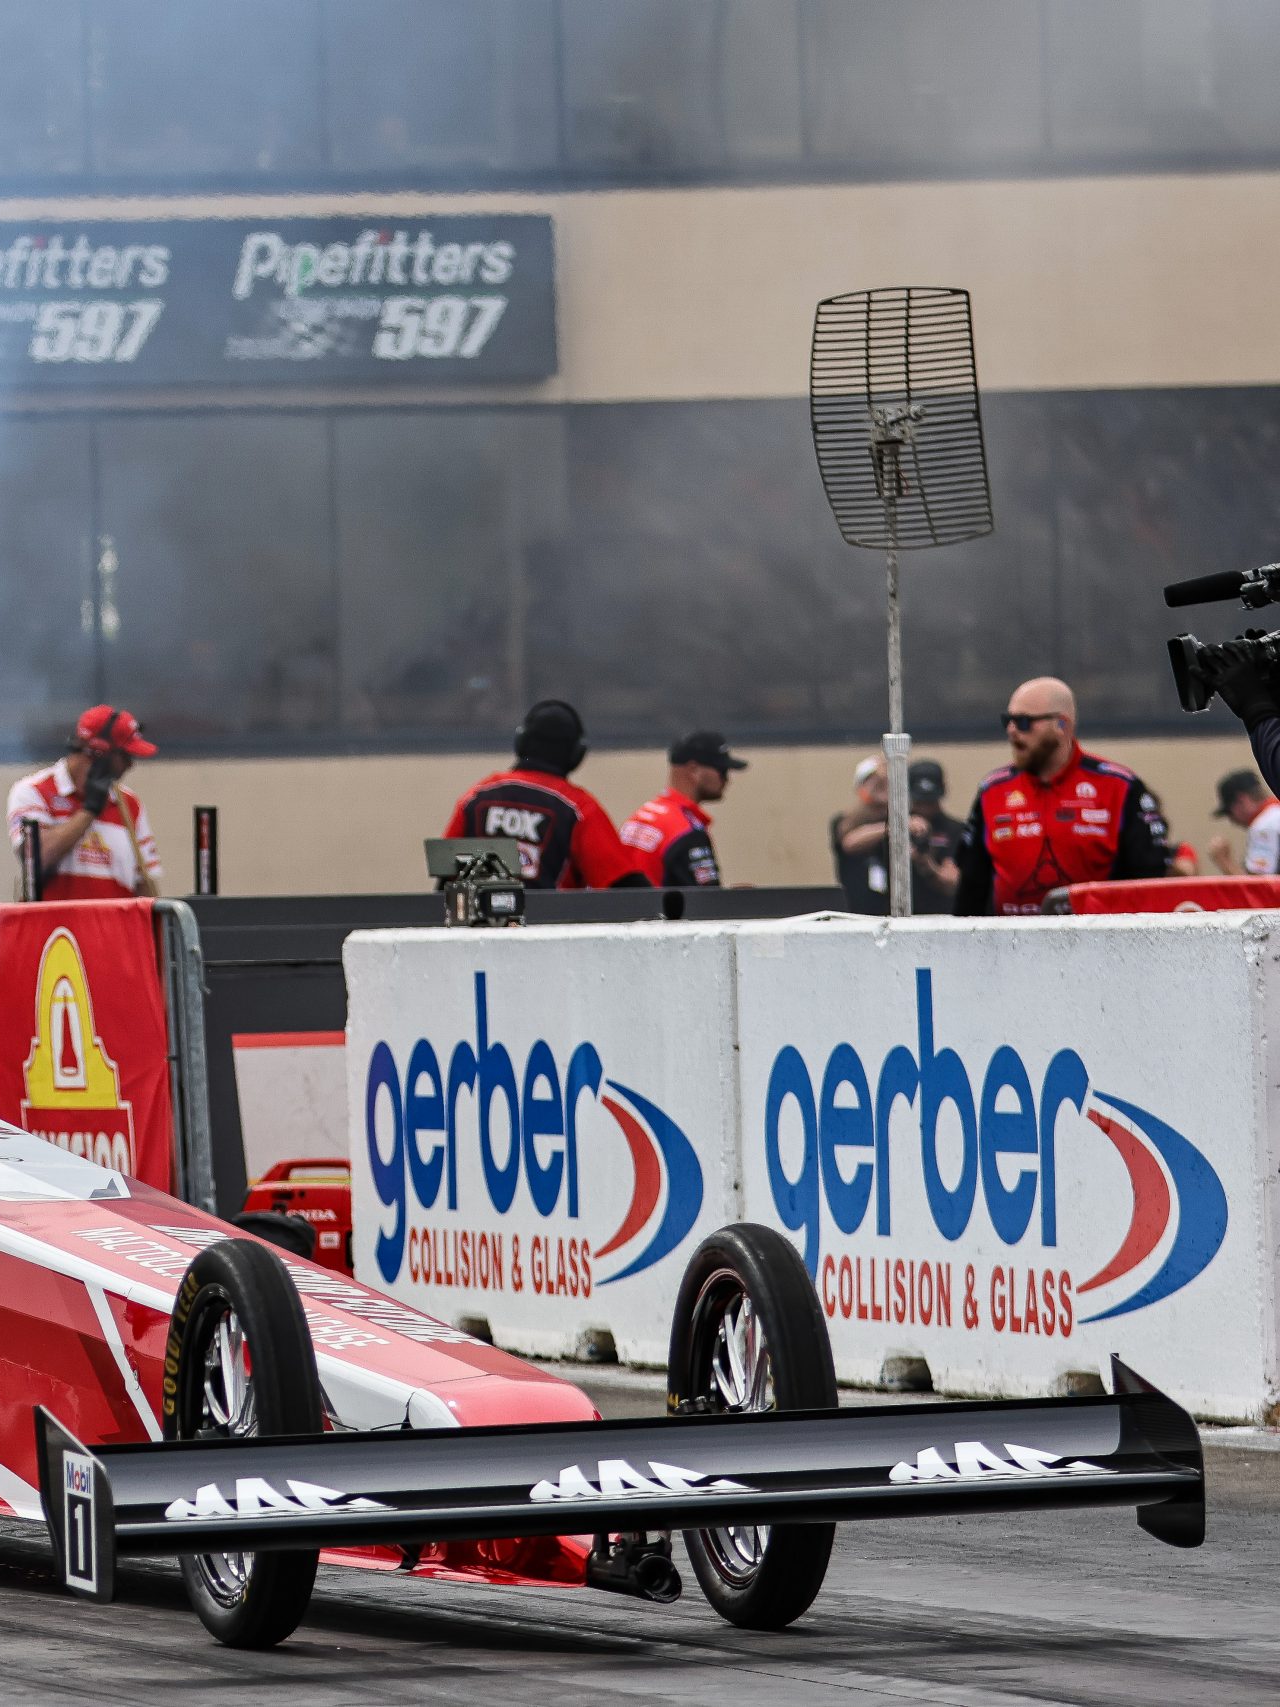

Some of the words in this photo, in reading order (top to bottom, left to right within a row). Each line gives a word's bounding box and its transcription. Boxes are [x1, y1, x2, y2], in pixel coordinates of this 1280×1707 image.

[232, 230, 515, 300] Pipefitters
[28, 299, 163, 363] 597
[372, 296, 508, 360] 597
[486, 806, 544, 842] FOX
[366, 970, 603, 1284] gerber
[765, 967, 1090, 1284] gerber
[408, 1226, 502, 1288] COLLISION
[511, 1236, 522, 1289] &
[531, 1236, 591, 1298] GLASS
[313, 1296, 493, 1348] FUTURE
[822, 1253, 952, 1328] COLLISION
[963, 1268, 979, 1329] &
[990, 1264, 1073, 1337] GLASS
[164, 1270, 201, 1416] GOODYEAR
[66, 1460, 91, 1494] Mobil
[529, 1459, 760, 1501] MAC
[889, 1441, 1118, 1484] MAC
[165, 1477, 398, 1519] MAC
[74, 1503, 85, 1571] 1
